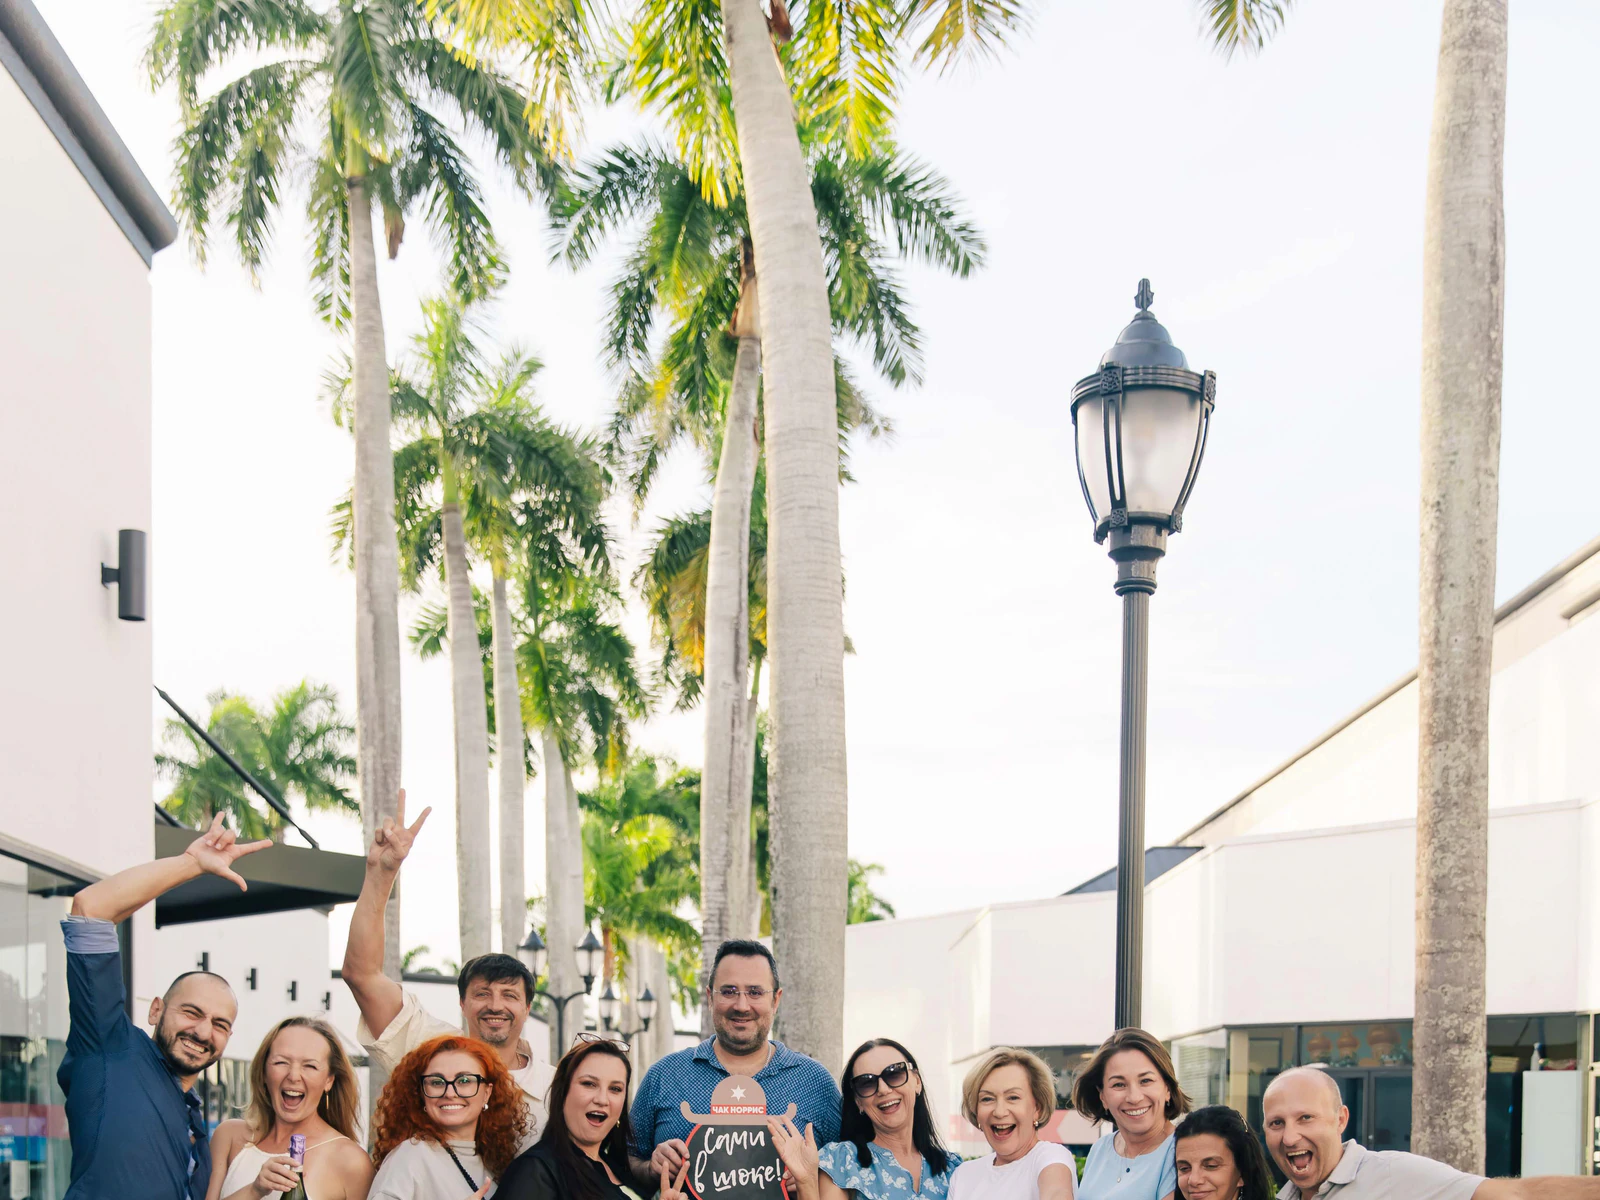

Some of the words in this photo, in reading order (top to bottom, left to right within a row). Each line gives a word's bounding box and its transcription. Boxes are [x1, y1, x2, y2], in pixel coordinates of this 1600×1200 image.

[712, 1106, 729, 1114] ЧАК
[730, 1106, 764, 1114] НОРРИС
[704, 1127, 765, 1156] Сами
[694, 1150, 708, 1193] в
[712, 1158, 782, 1192] шоке!
